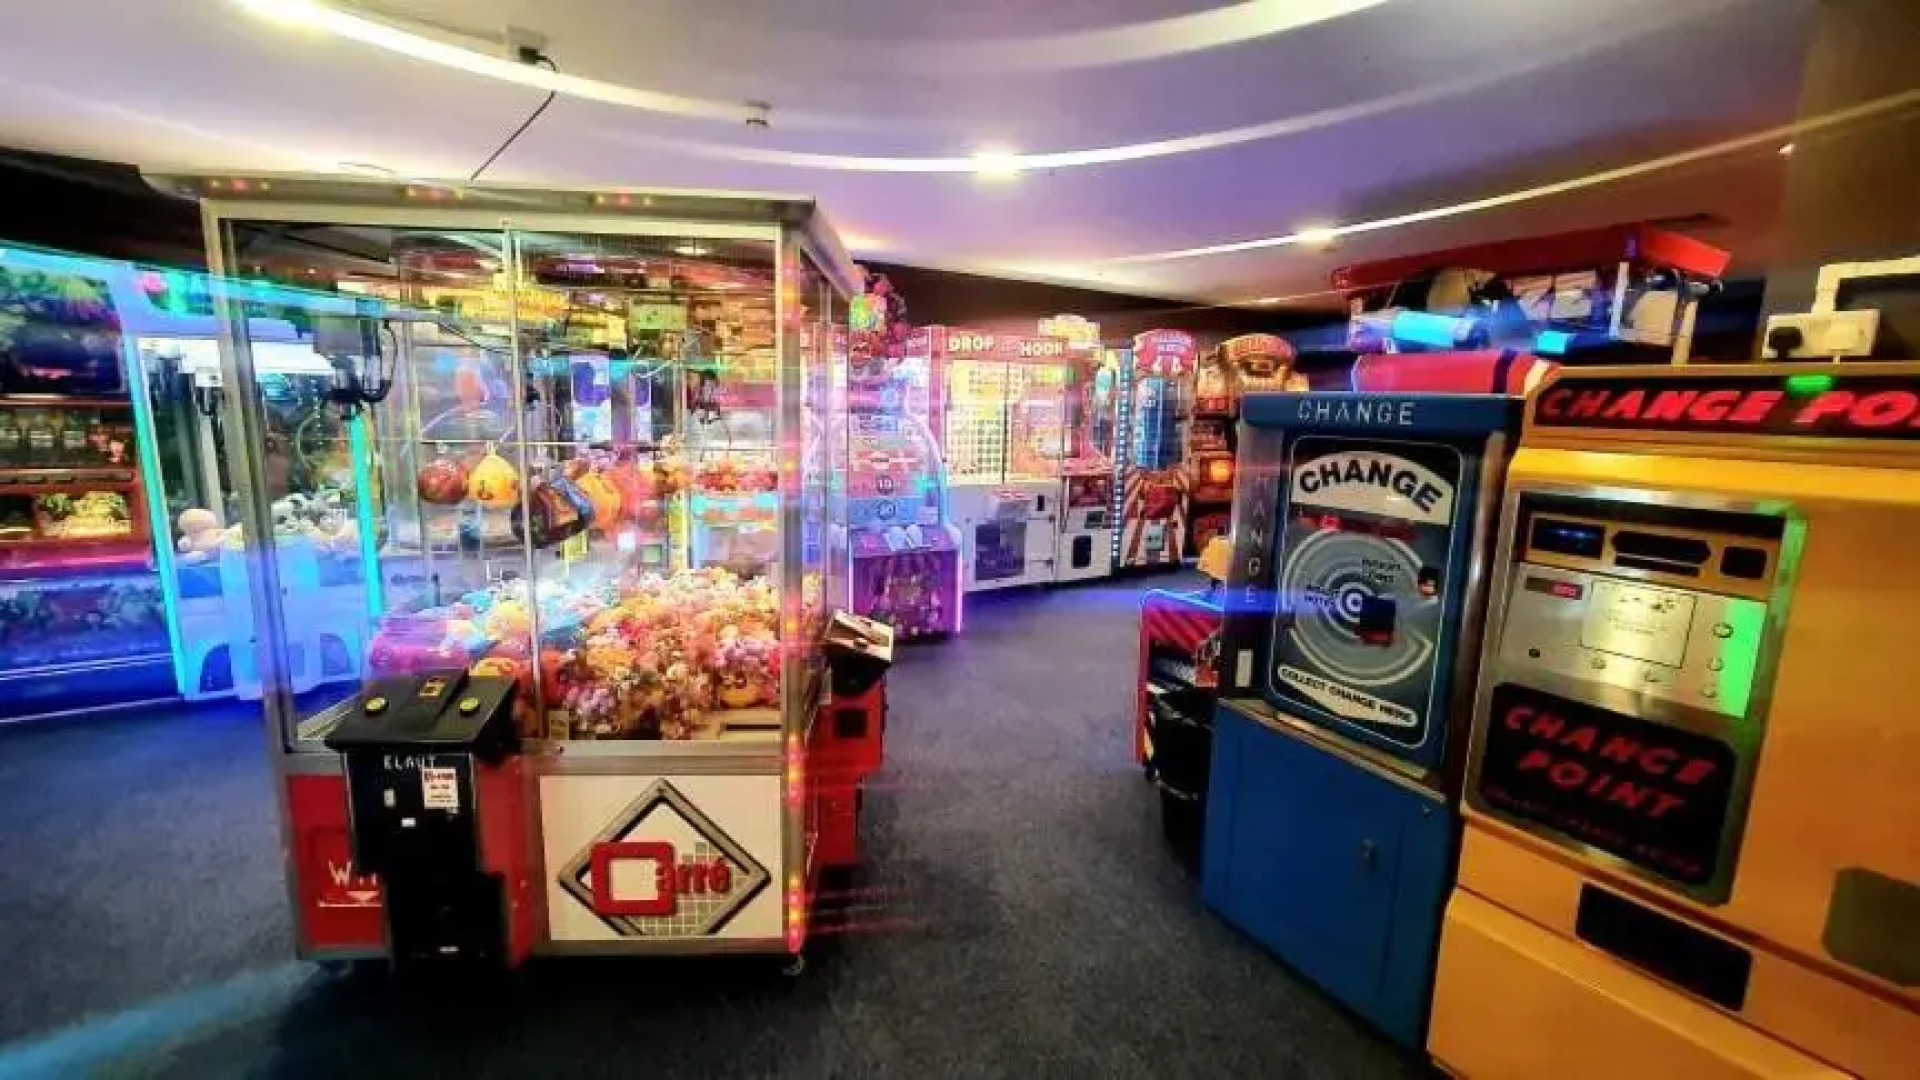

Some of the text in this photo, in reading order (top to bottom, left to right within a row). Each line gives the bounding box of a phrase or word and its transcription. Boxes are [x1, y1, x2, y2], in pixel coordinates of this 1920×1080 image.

[948, 335, 995, 353] DROP
[1298, 400, 1415, 426] CHANGE
[1541, 388, 1920, 428] CHANGE PO
[1300, 459, 1443, 514] CHANGE
[1504, 706, 1717, 785] CHANGE
[1517, 750, 1686, 818] POINT
